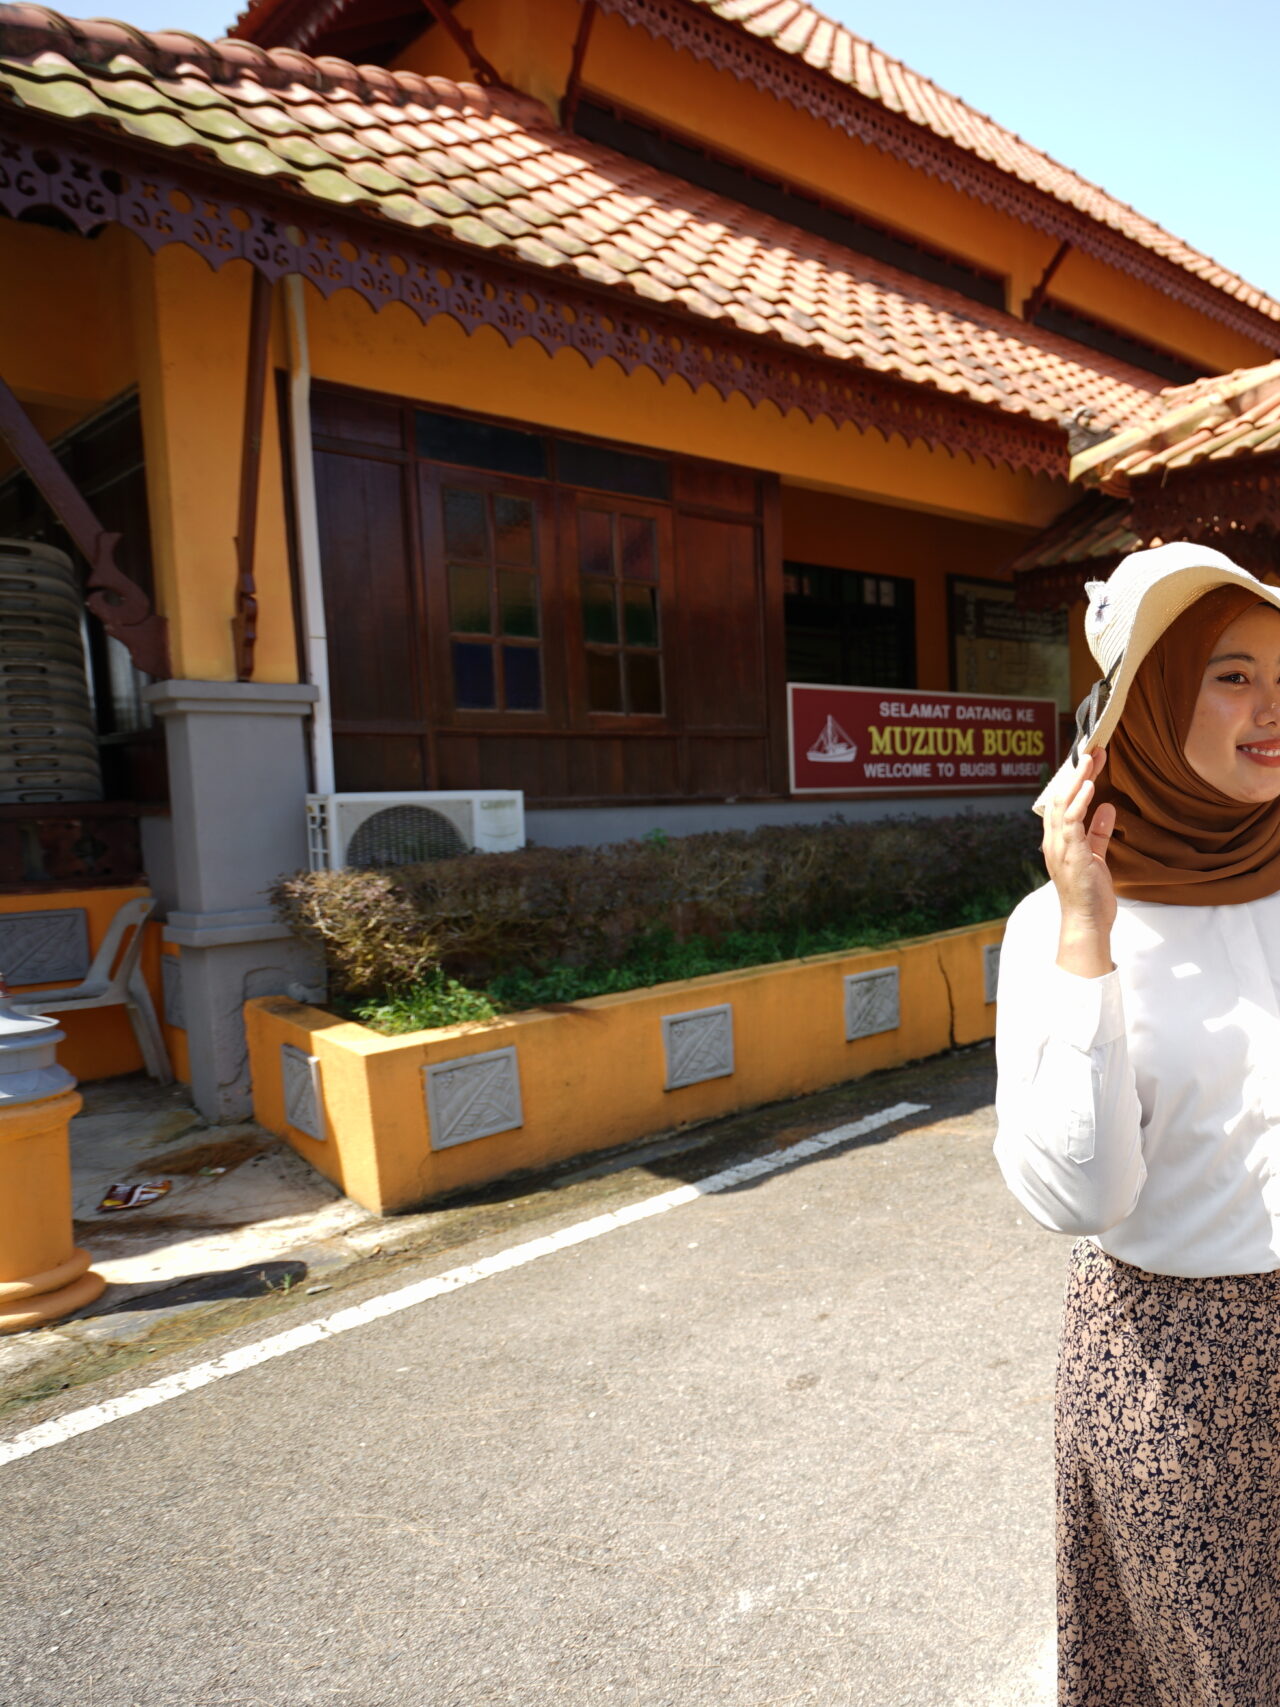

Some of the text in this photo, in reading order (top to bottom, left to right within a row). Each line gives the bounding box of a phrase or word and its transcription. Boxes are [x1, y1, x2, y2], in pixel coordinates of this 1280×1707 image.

[879, 701, 1035, 722] SELAMAT DATANG KE
[868, 726, 1044, 756] MUZIUM BUGIS
[863, 762, 1046, 779] WELCOME TO BUGIS MUSEU
